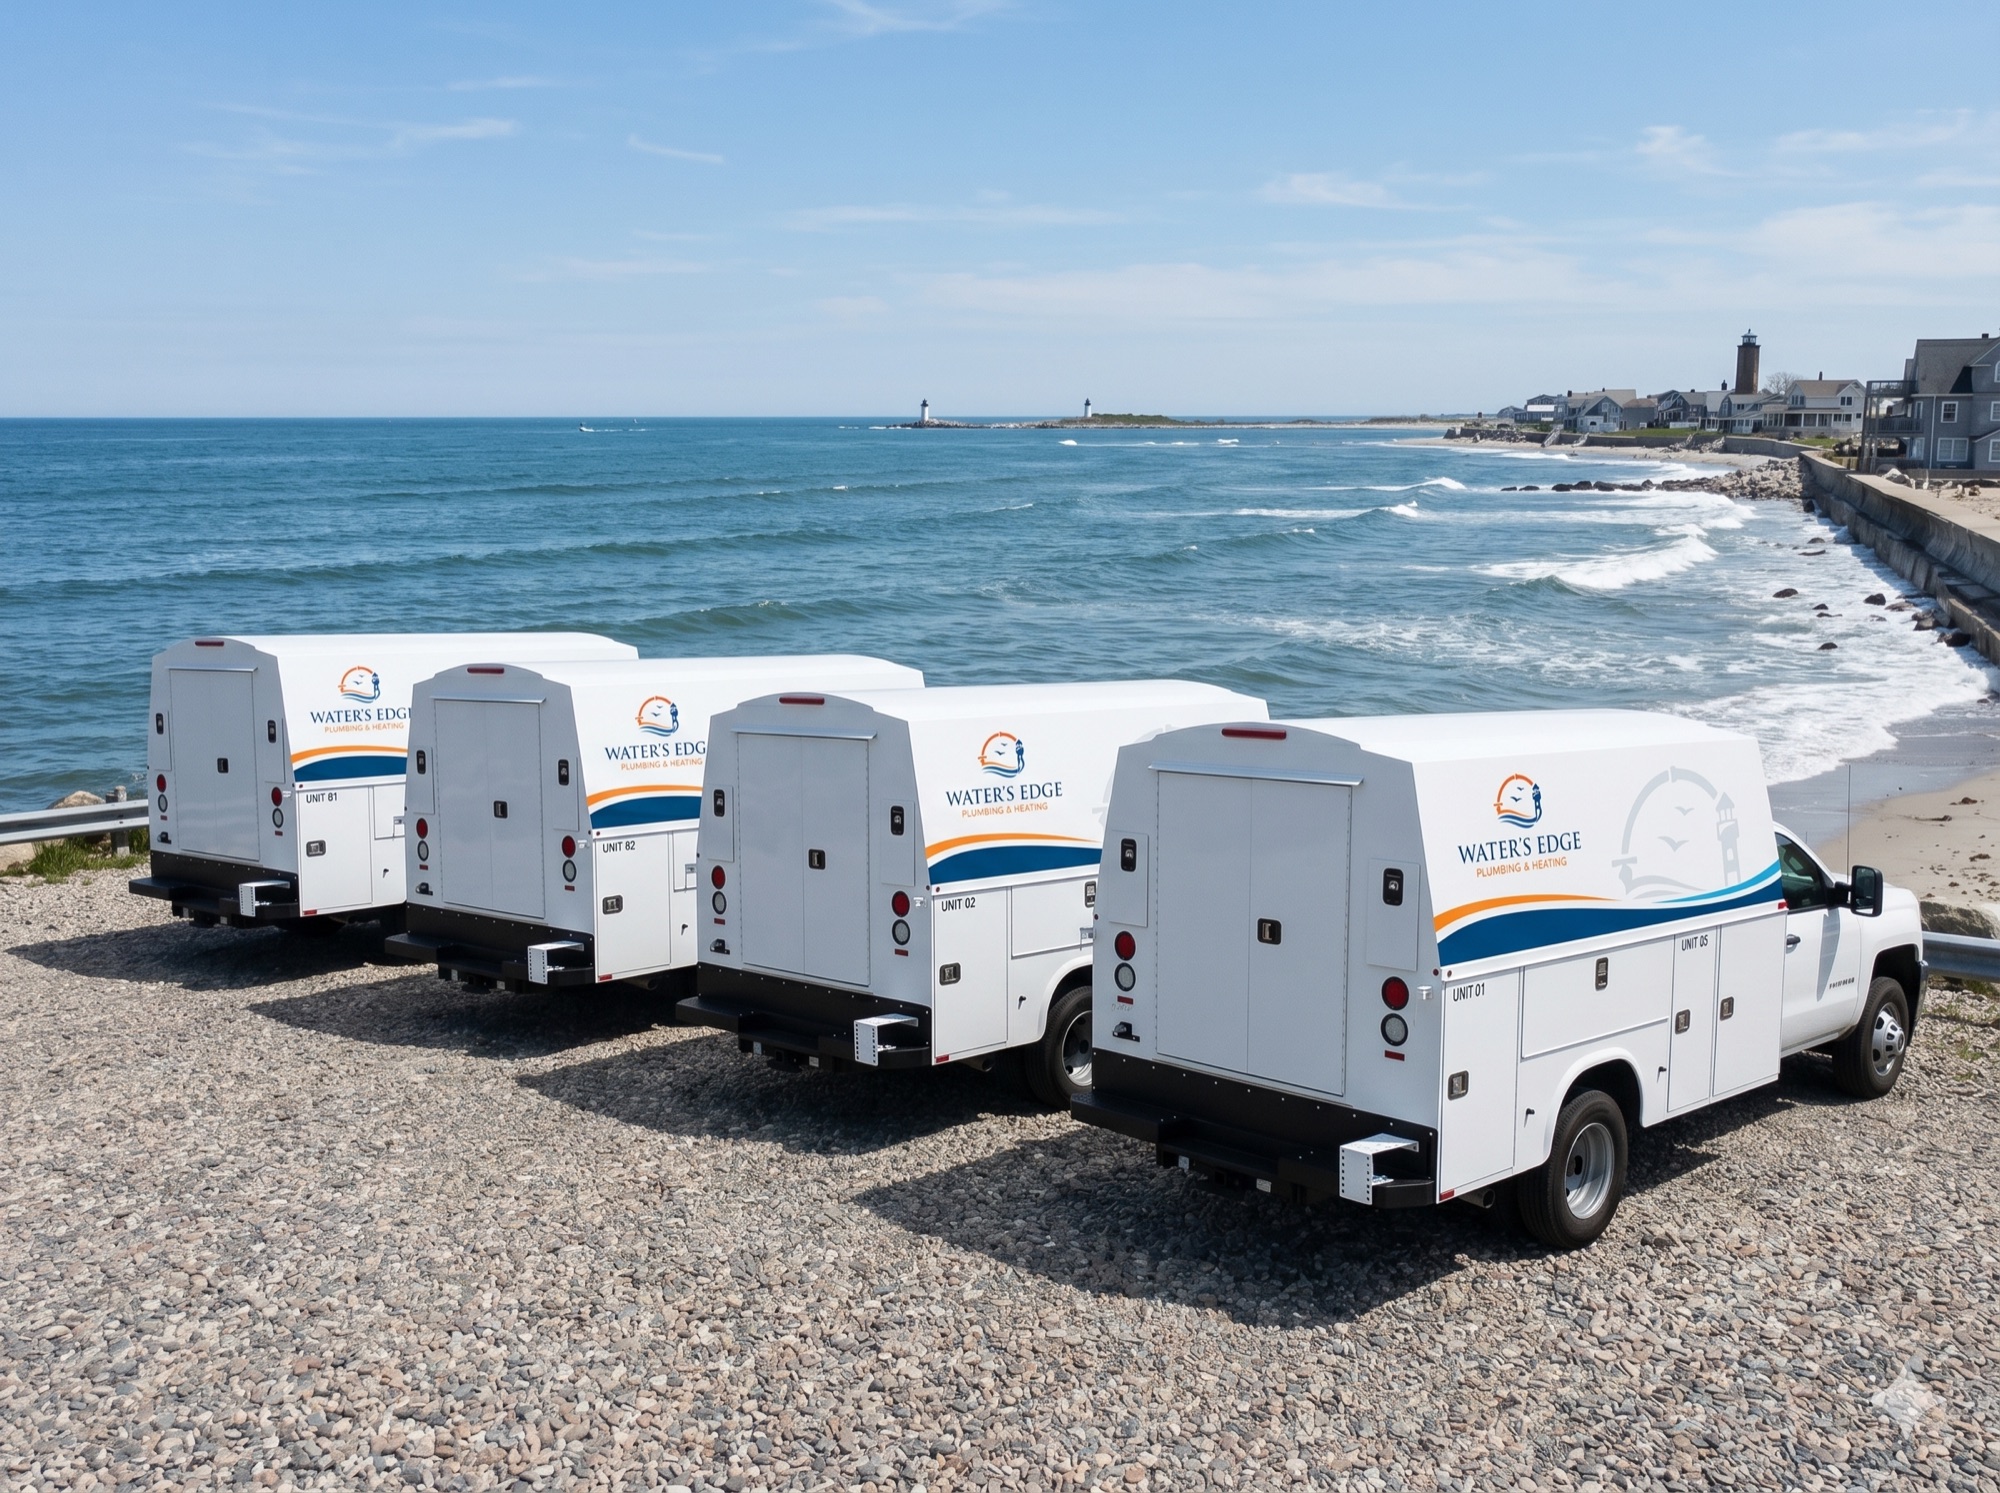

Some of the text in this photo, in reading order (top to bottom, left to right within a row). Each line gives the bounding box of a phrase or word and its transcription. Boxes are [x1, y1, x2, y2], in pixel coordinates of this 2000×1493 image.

[310, 708, 372, 724] WATER'S
[324, 722, 404, 733] PLUMBING & HEATING
[605, 741, 706, 760] WATER'S EDG
[621, 758, 703, 771] PLUMBING & HEATING
[306, 792, 337, 804] UNIT 81
[946, 781, 1063, 807] WATER'S EDGE
[961, 802, 1048, 818] PLUMBING & HEATING
[602, 840, 636, 853] UNIT 82
[1458, 831, 1582, 864] WATER'S EDGE
[1476, 856, 1567, 878] PLUMBING & HEATING
[941, 896, 976, 912] UNIT 02
[1682, 936, 1698, 951] UNIT
[1453, 982, 1486, 1002] UNIT 01
